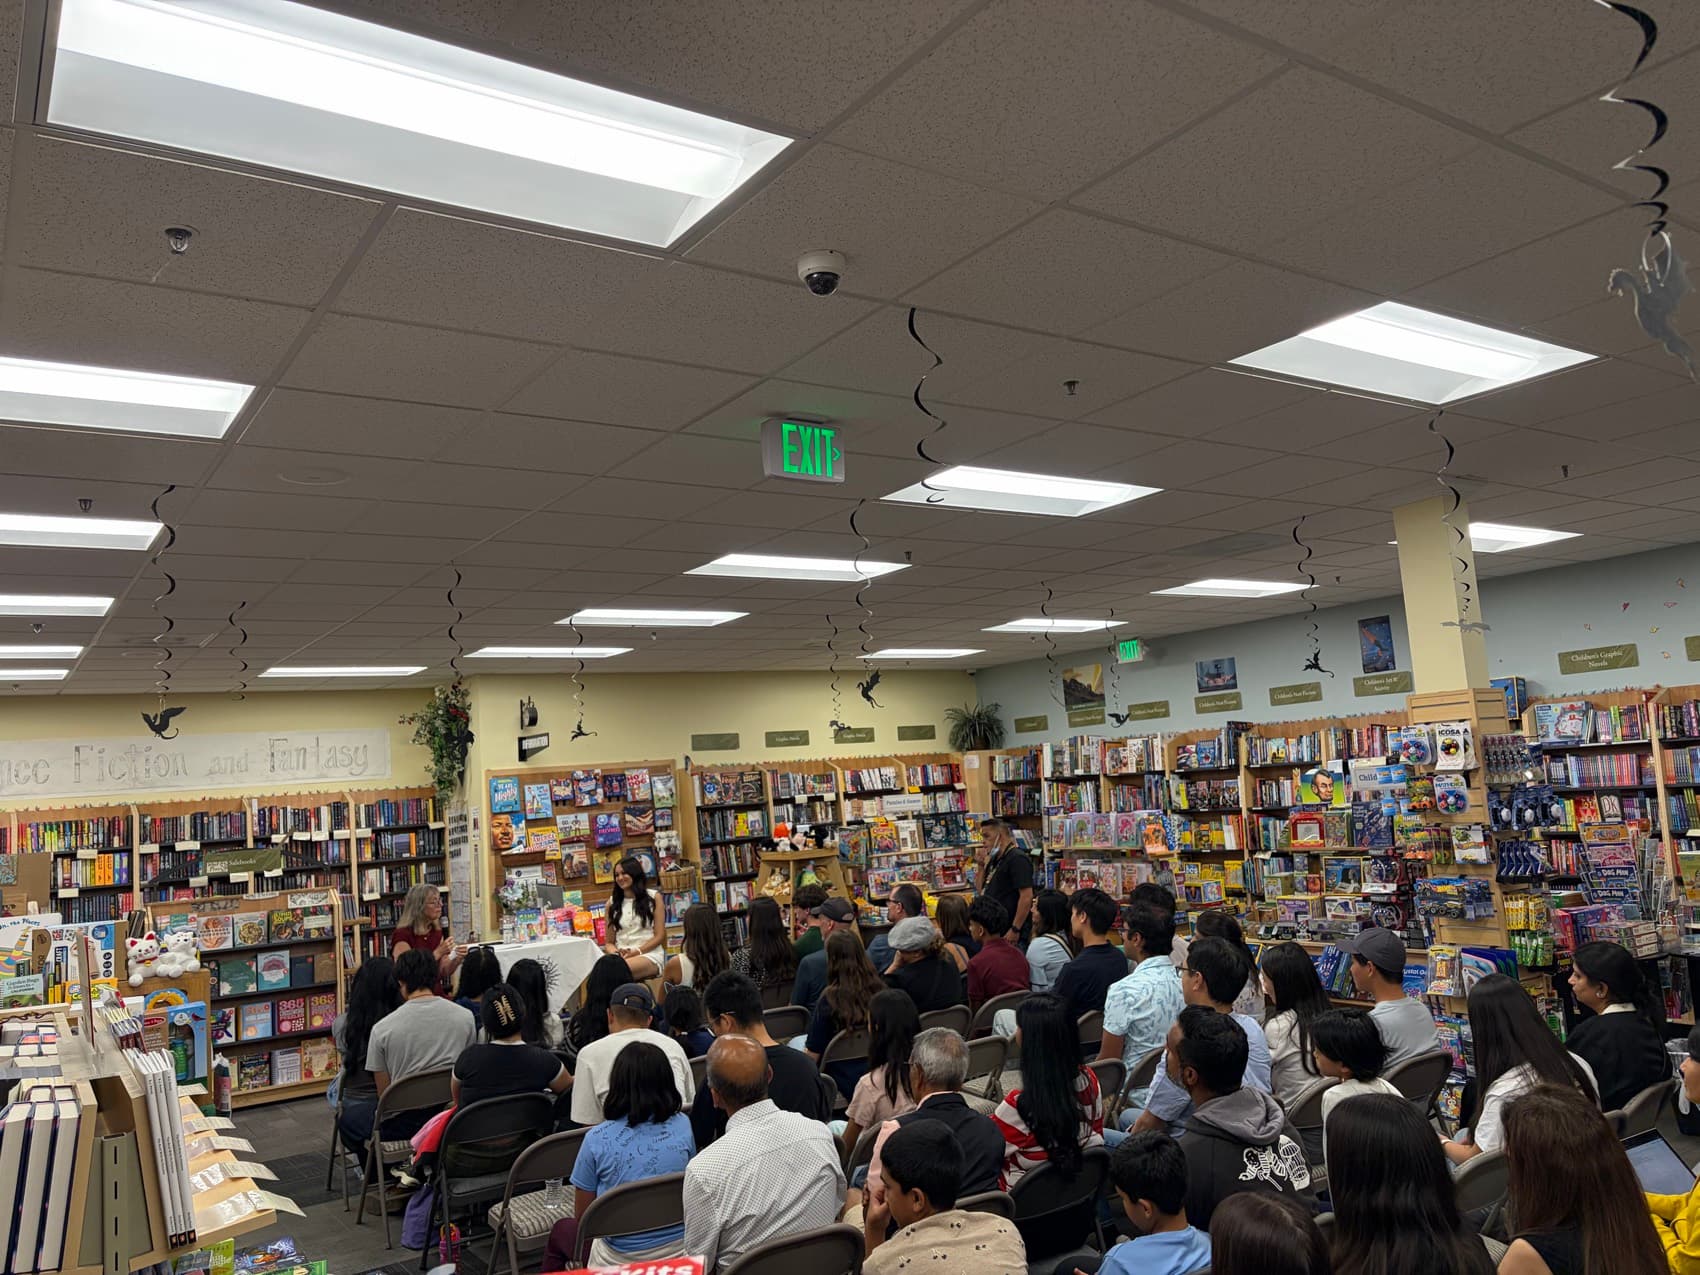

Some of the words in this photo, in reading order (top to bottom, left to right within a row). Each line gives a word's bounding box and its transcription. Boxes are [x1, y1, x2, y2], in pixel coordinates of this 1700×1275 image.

[782, 423, 835, 477] EXIT
[1119, 640, 1139, 661] EXIT
[73, 743, 188, 785] Fiction
[205, 749, 248, 777] and
[268, 736, 369, 777] Fantasy
[1603, 797, 1619, 814] DK
